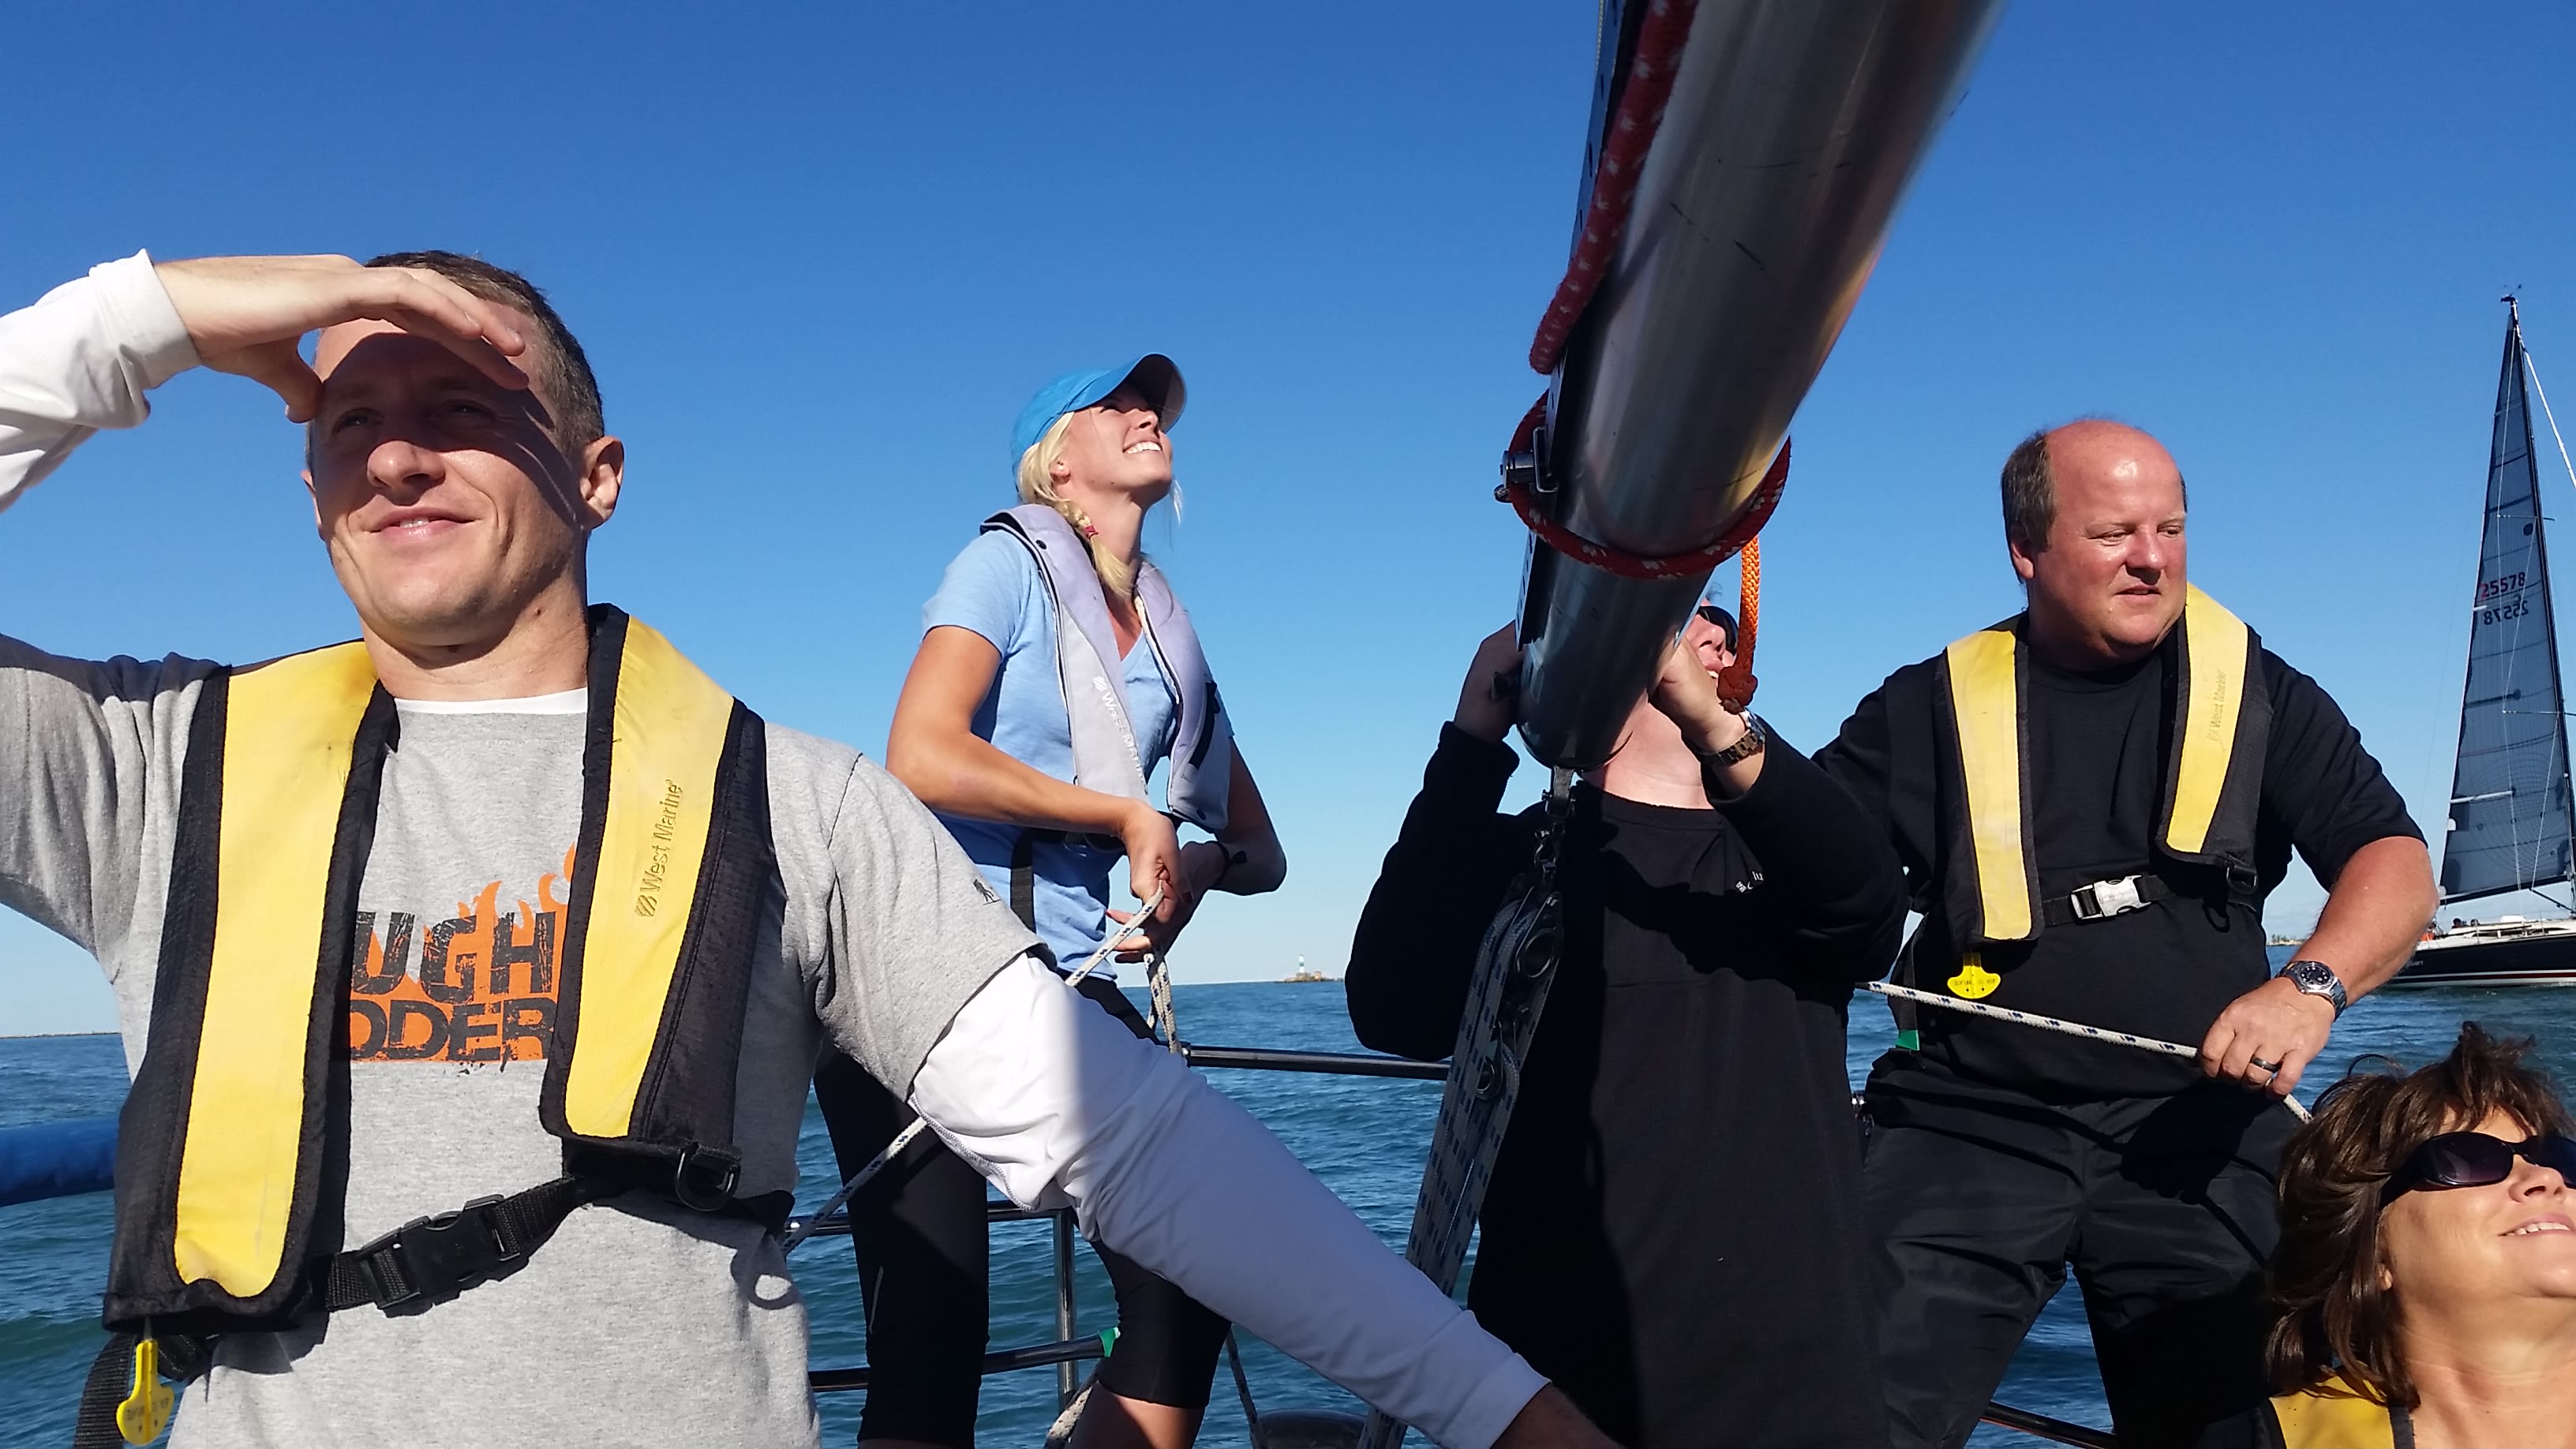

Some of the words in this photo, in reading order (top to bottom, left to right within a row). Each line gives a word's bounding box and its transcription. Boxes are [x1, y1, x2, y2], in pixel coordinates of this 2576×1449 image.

[2480, 571, 2525, 598] 25578
[653, 784, 683, 841] Marine
[640, 845, 670, 892] West
